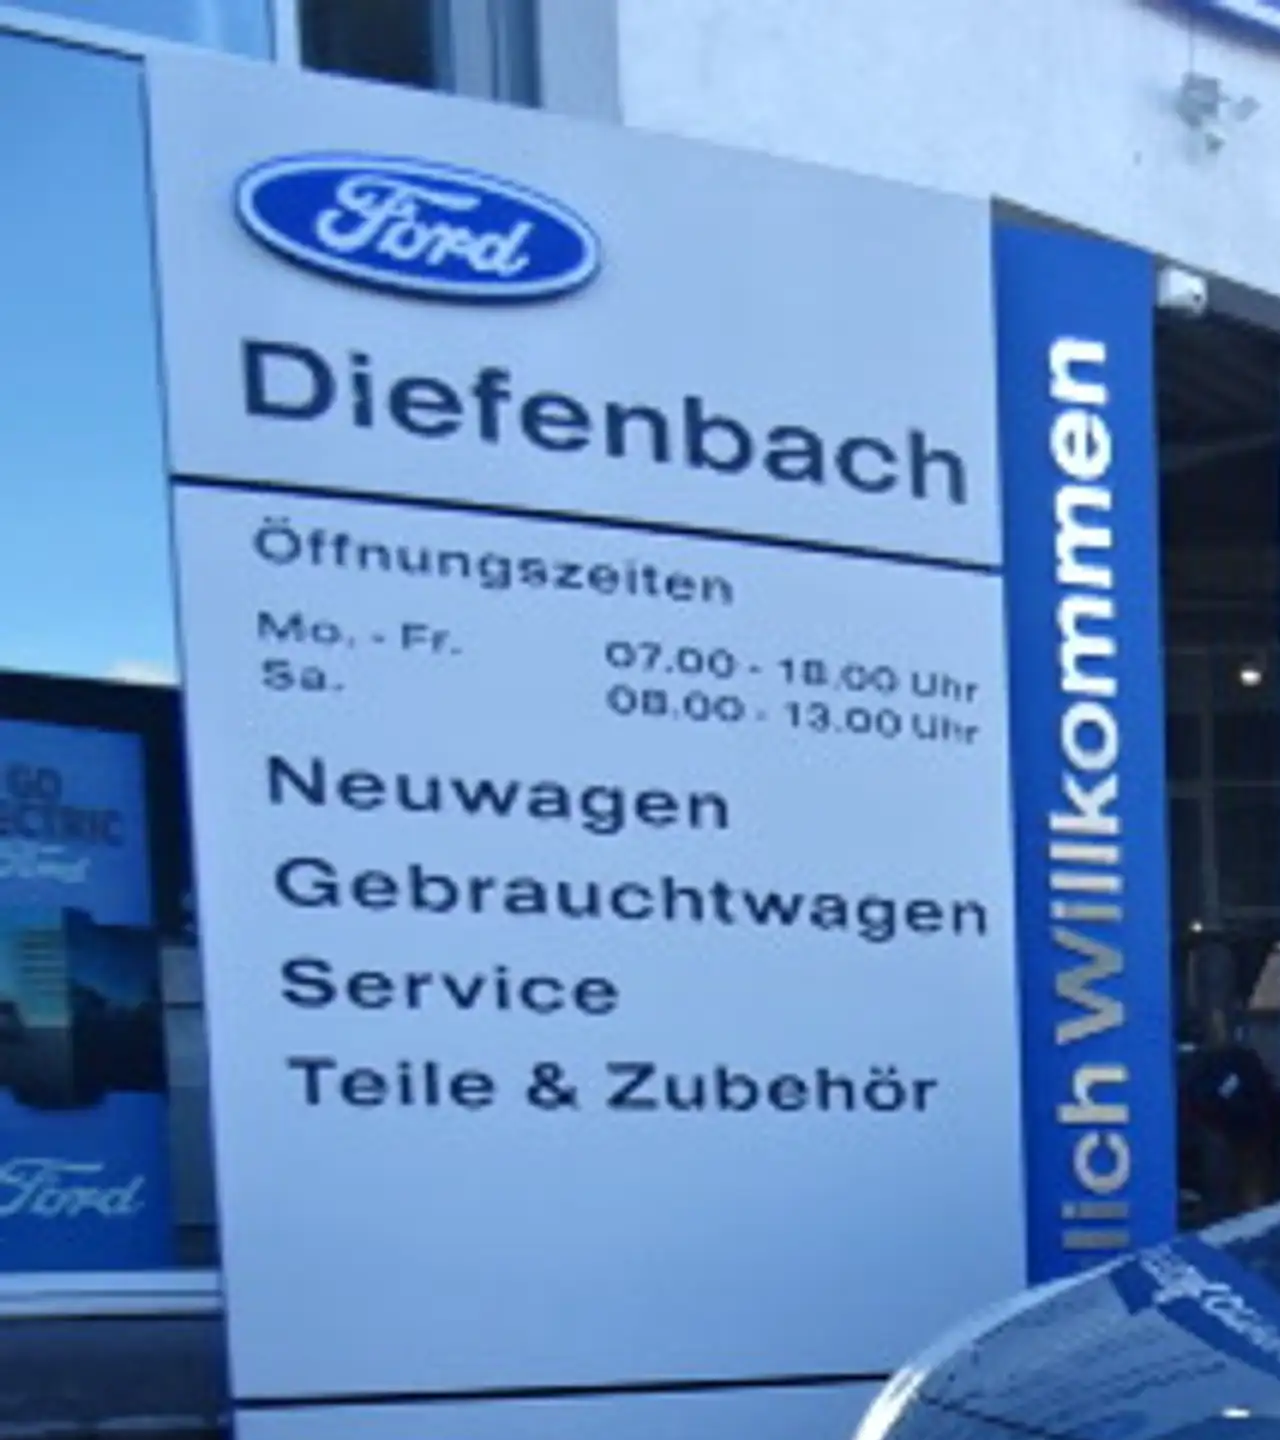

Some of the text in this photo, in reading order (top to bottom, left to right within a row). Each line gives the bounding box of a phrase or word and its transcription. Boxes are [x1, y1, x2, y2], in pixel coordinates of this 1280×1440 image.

[313, 172, 532, 277] Ford
[240, 337, 967, 506] Diefenbach
[252, 516, 736, 606] Öffnungszeiten
[256, 610, 356, 649] Mo.
[401, 621, 463, 655] Fr.
[603, 640, 735, 678] 07.00
[778, 658, 899, 694] 18.00
[910, 670, 980, 703] Uhr
[261, 658, 346, 692] Sa.
[606, 684, 746, 723] 08.00
[784, 701, 902, 739] 13.00
[910, 713, 980, 746] Uhr
[266, 754, 731, 836] Neuwagen
[1048, 335, 1132, 1251] lich Willkommen
[273, 856, 989, 944] Gebrauchtwagen
[280, 957, 620, 1016] Service
[286, 1056, 938, 1113] Teile & Zubehör
[0, 1156, 146, 1218] Ford
